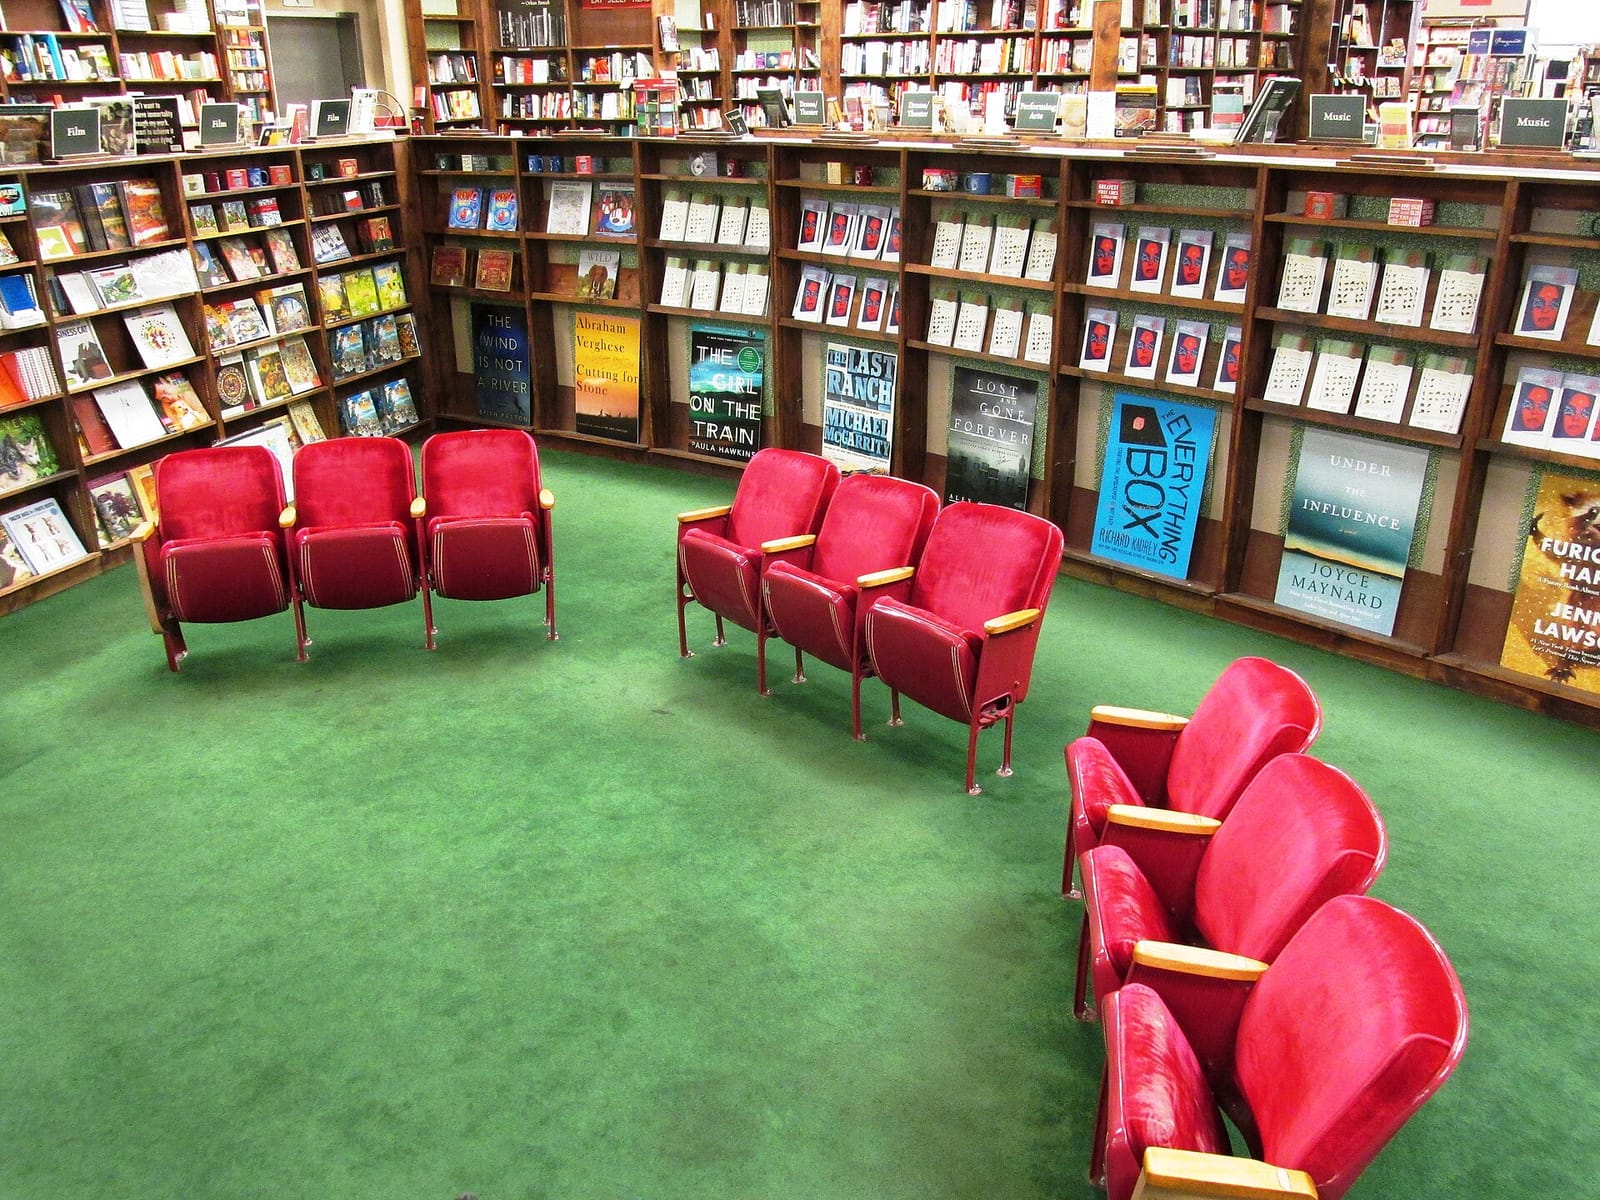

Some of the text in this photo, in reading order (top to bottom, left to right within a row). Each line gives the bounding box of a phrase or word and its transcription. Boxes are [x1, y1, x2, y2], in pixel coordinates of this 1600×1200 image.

[1020, 102, 1057, 112] Performing
[1324, 111, 1352, 121] Music
[212, 119, 227, 128] Film
[327, 112, 340, 122] Film
[1516, 117, 1550, 128] Music
[67, 126, 86, 137] Film
[488, 314, 512, 329] THE
[576, 317, 626, 334] Abraham
[482, 335, 518, 351] WIND
[576, 336, 625, 353] Verghese
[479, 356, 522, 373] IS NOT
[696, 345, 733, 366] THE
[829, 348, 896, 379] THE LAST
[576, 364, 638, 384] Cutting for
[478, 376, 528, 394] A RIVER
[576, 380, 608, 396] Stone
[712, 374, 758, 395] GIRL
[828, 370, 892, 405] RANCH
[976, 379, 1018, 397] LOST
[690, 396, 760, 421] ON THE
[1000, 398, 1017, 406] AND
[980, 402, 1025, 422] GONE
[1162, 409, 1176, 421] THE
[826, 407, 888, 438] MICHAEL
[954, 418, 1028, 444] FOREVER
[694, 420, 754, 446] TRAIN
[692, 441, 755, 458] PAULA HAWKINS
[1330, 455, 1390, 477] UNDER
[1122, 447, 1168, 539] BOX
[1158, 414, 1197, 564] EVERYTHING
[1345, 486, 1366, 497] THE
[1302, 499, 1400, 530] INFLUENCE
[1100, 528, 1130, 548] RICHARD
[1132, 534, 1158, 557] KADREY
[1312, 562, 1370, 588] JOYCE
[1292, 575, 1382, 610] MAYNARD
[1544, 578, 1562, 588] Funny
[1564, 583, 1580, 592] Book
[1580, 586, 1600, 596] About
[1534, 618, 1600, 648] LAWS
